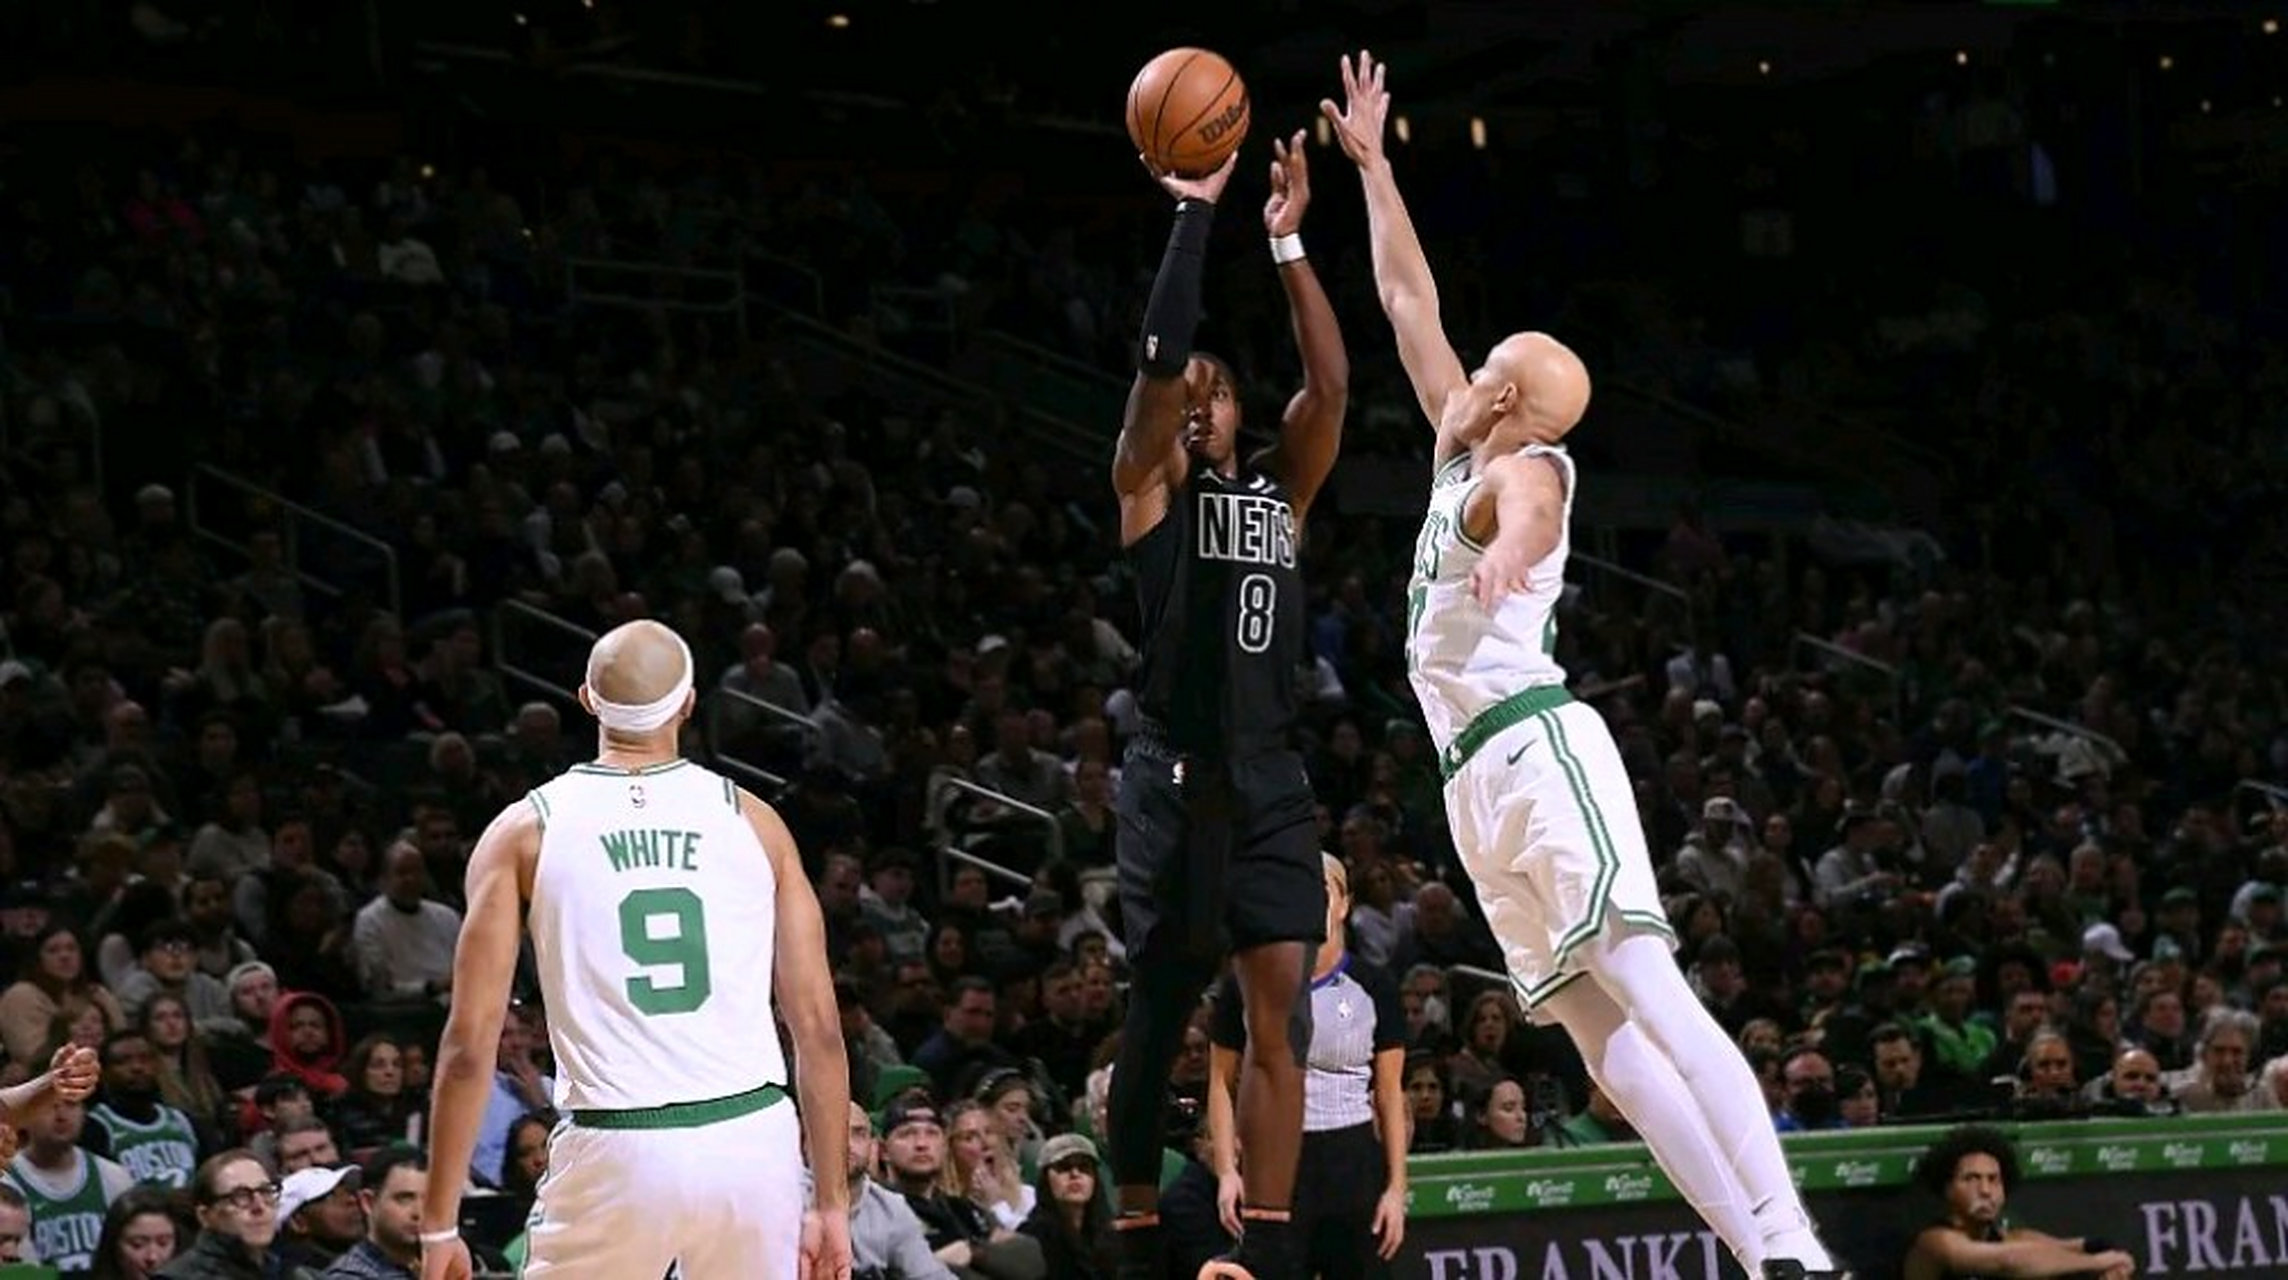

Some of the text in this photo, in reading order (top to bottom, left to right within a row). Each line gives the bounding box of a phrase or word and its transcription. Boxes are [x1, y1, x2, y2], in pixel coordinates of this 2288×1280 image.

[1199, 493, 1296, 569] NETS
[1238, 574, 1276, 653] 8
[600, 829, 702, 873] WHITE
[618, 887, 712, 1016] 9
